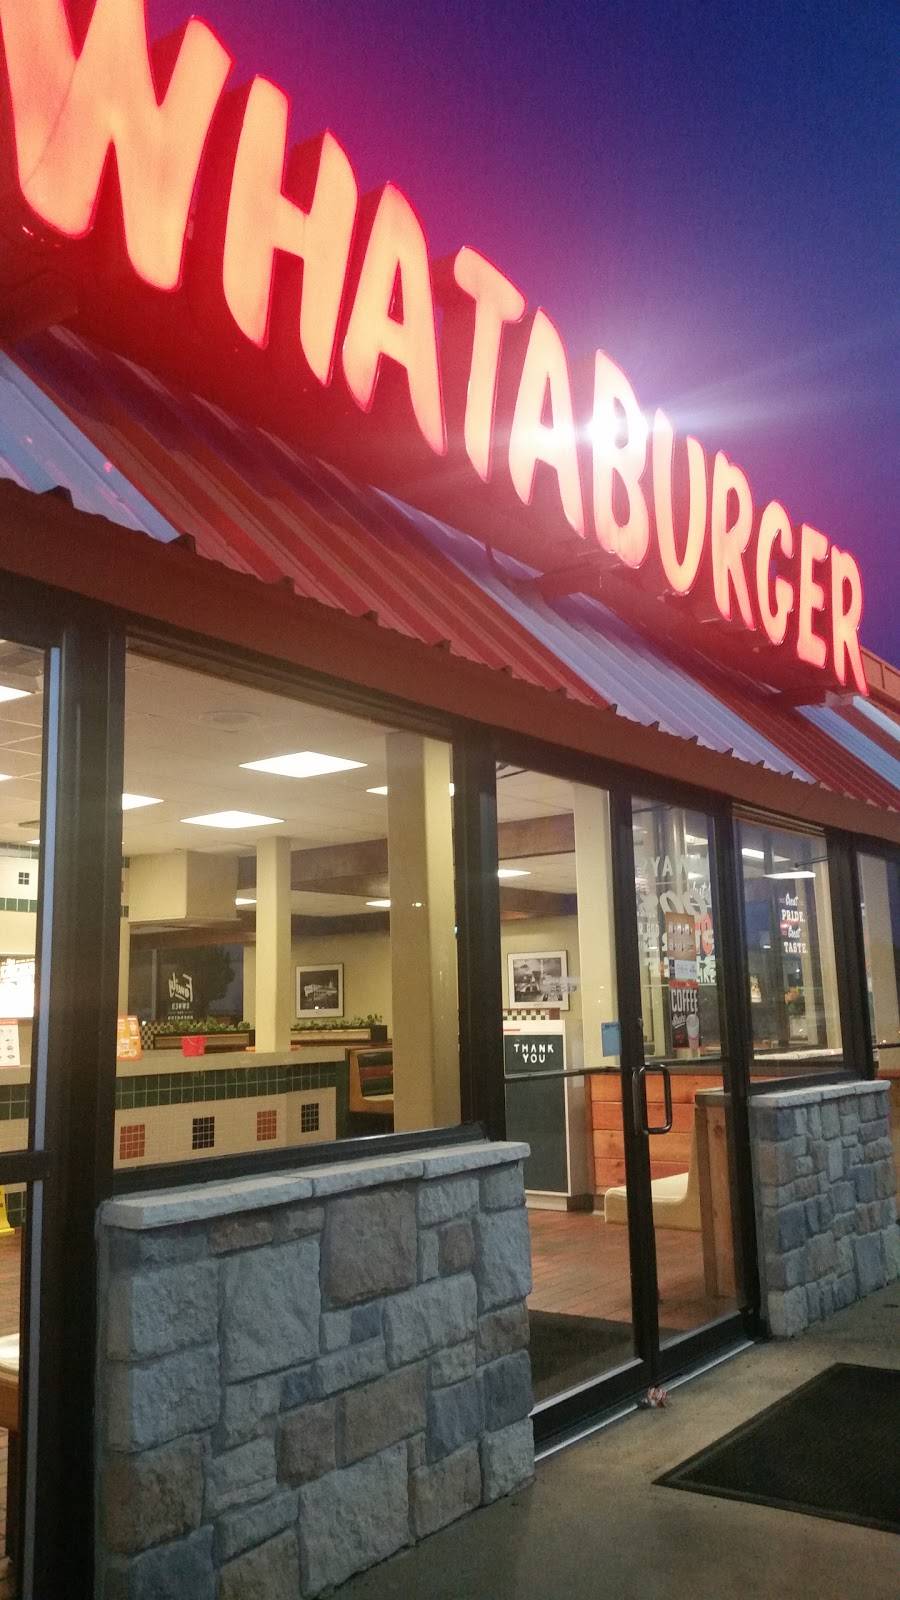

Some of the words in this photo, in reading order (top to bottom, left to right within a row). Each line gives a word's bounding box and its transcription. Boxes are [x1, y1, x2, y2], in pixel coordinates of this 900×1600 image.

[0, 0, 869, 697] WHATABURGER
[671, 989, 698, 1012] COFFEE
[513, 1043, 554, 1053] THANK
[522, 1053, 546, 1063] YOU
